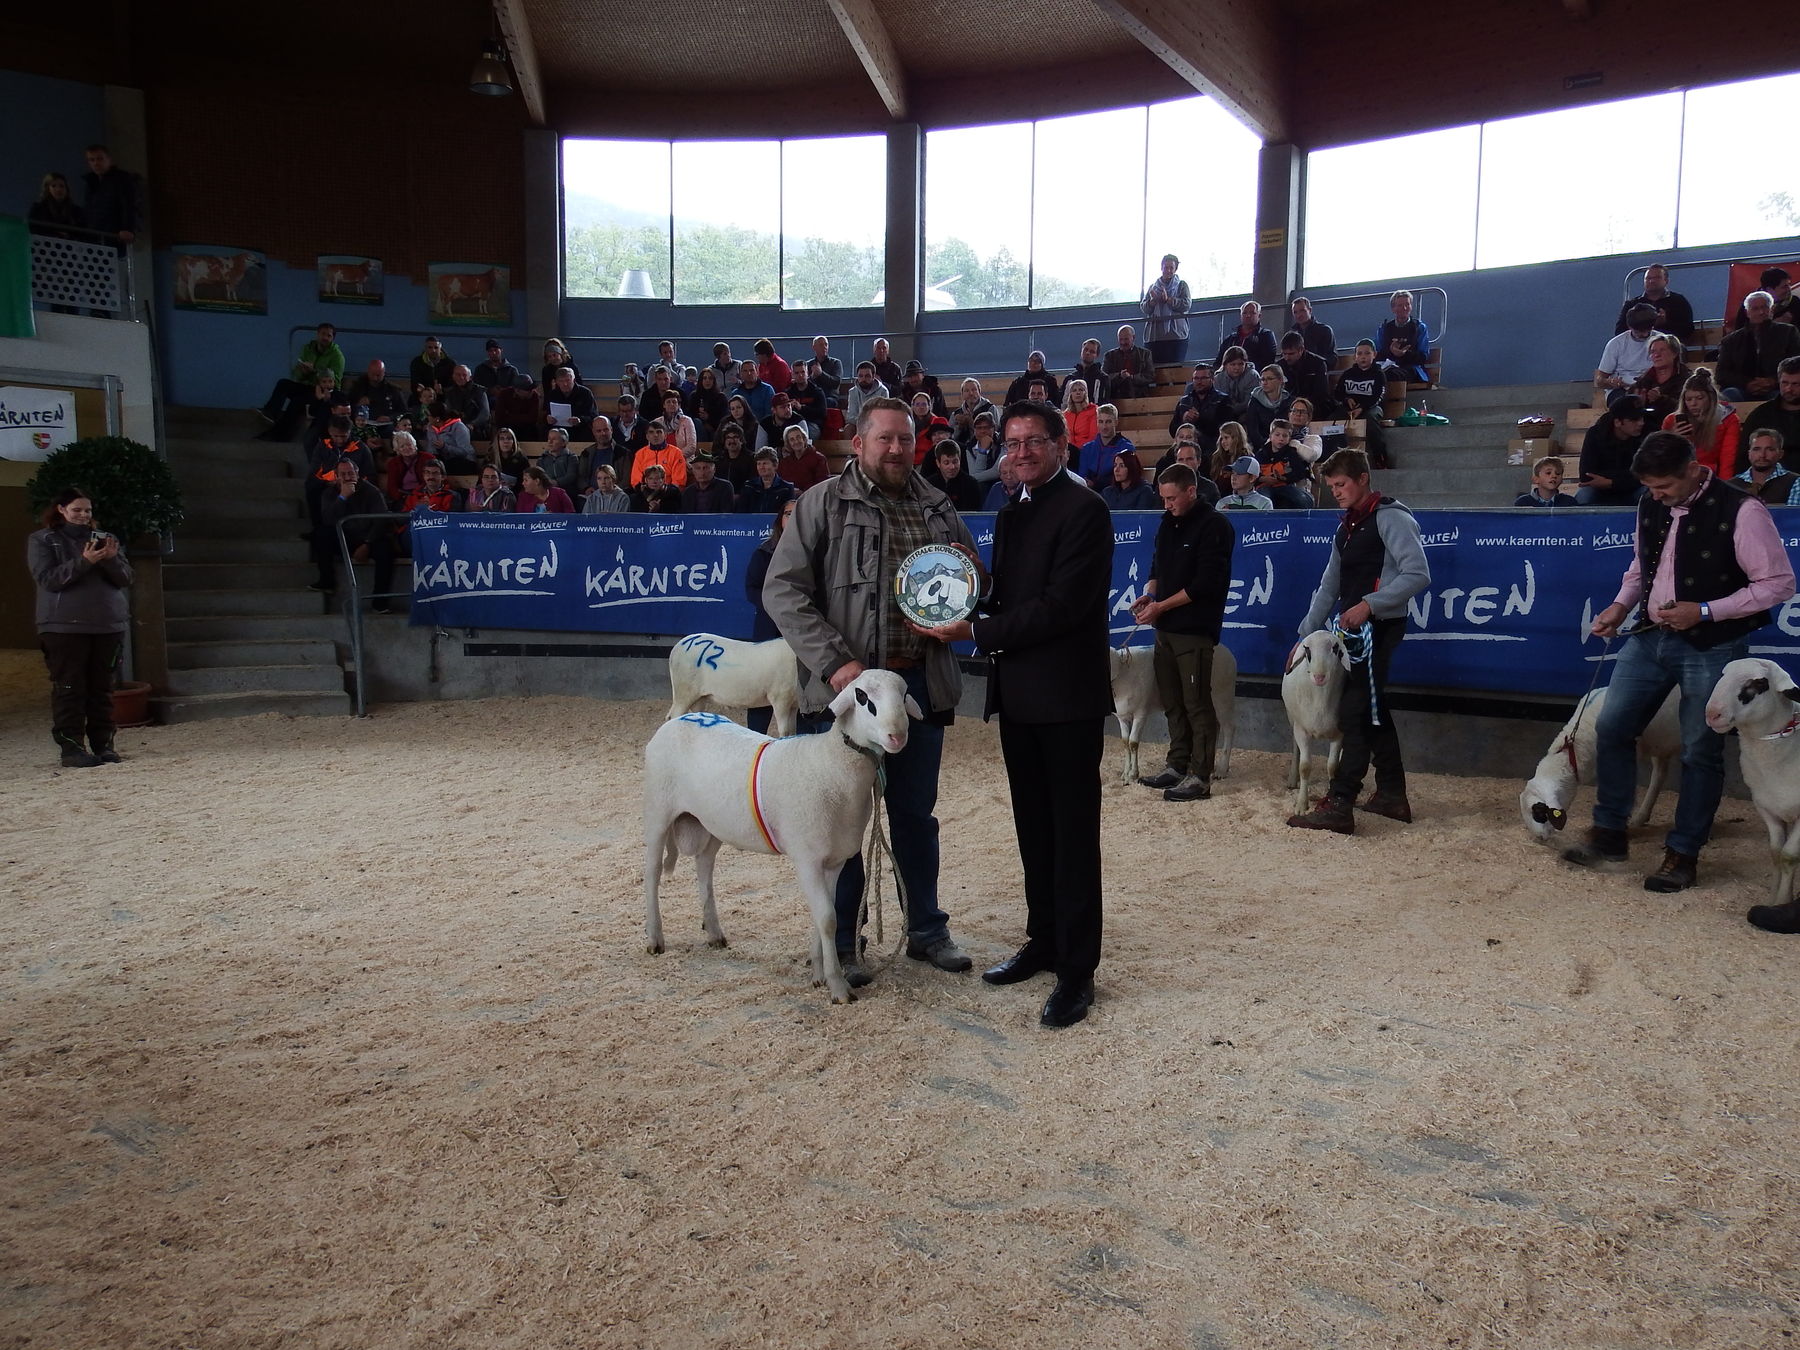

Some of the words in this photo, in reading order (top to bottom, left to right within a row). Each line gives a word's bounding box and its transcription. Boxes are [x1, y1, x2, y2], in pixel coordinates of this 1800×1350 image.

[459, 521, 525, 530] www.kaernten.at
[577, 525, 644, 534] www.kaernten.at
[693, 528, 755, 537] www.kaernten.at
[1420, 527, 1459, 545] RNTEN
[1475, 536, 1584, 546] www.kaernten.at
[1406, 560, 1536, 630] NTEN
